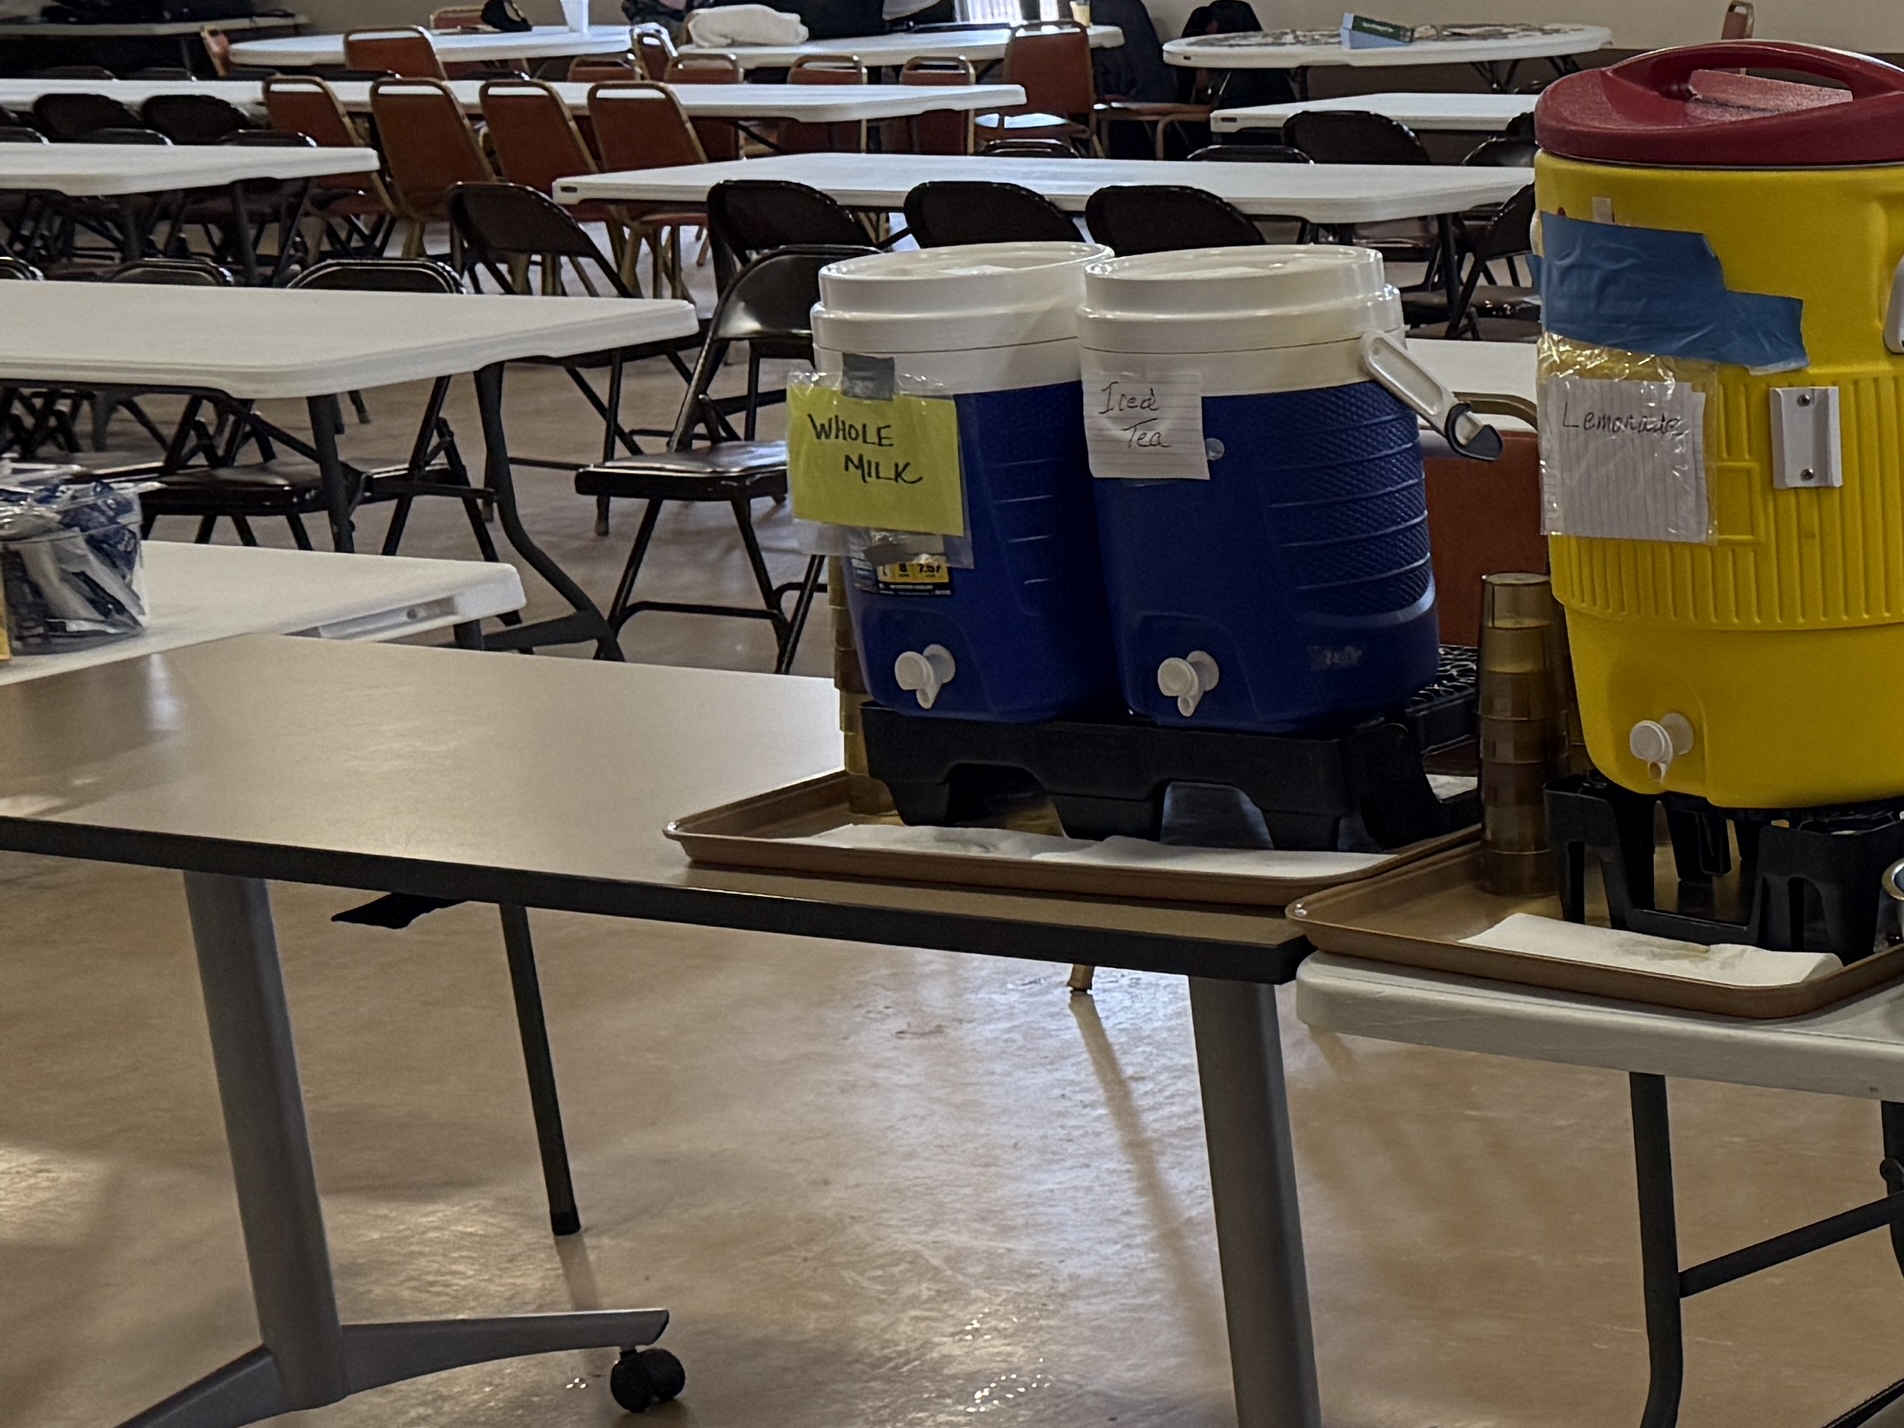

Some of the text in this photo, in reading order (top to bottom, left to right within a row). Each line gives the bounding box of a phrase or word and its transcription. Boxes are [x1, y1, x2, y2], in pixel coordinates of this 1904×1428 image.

[1098, 380, 1161, 414] Iced
[807, 412, 895, 449] WHOLE
[1121, 417, 1172, 450] Tea
[1562, 401, 1683, 436] Lemonade
[843, 452, 924, 486] MILK
